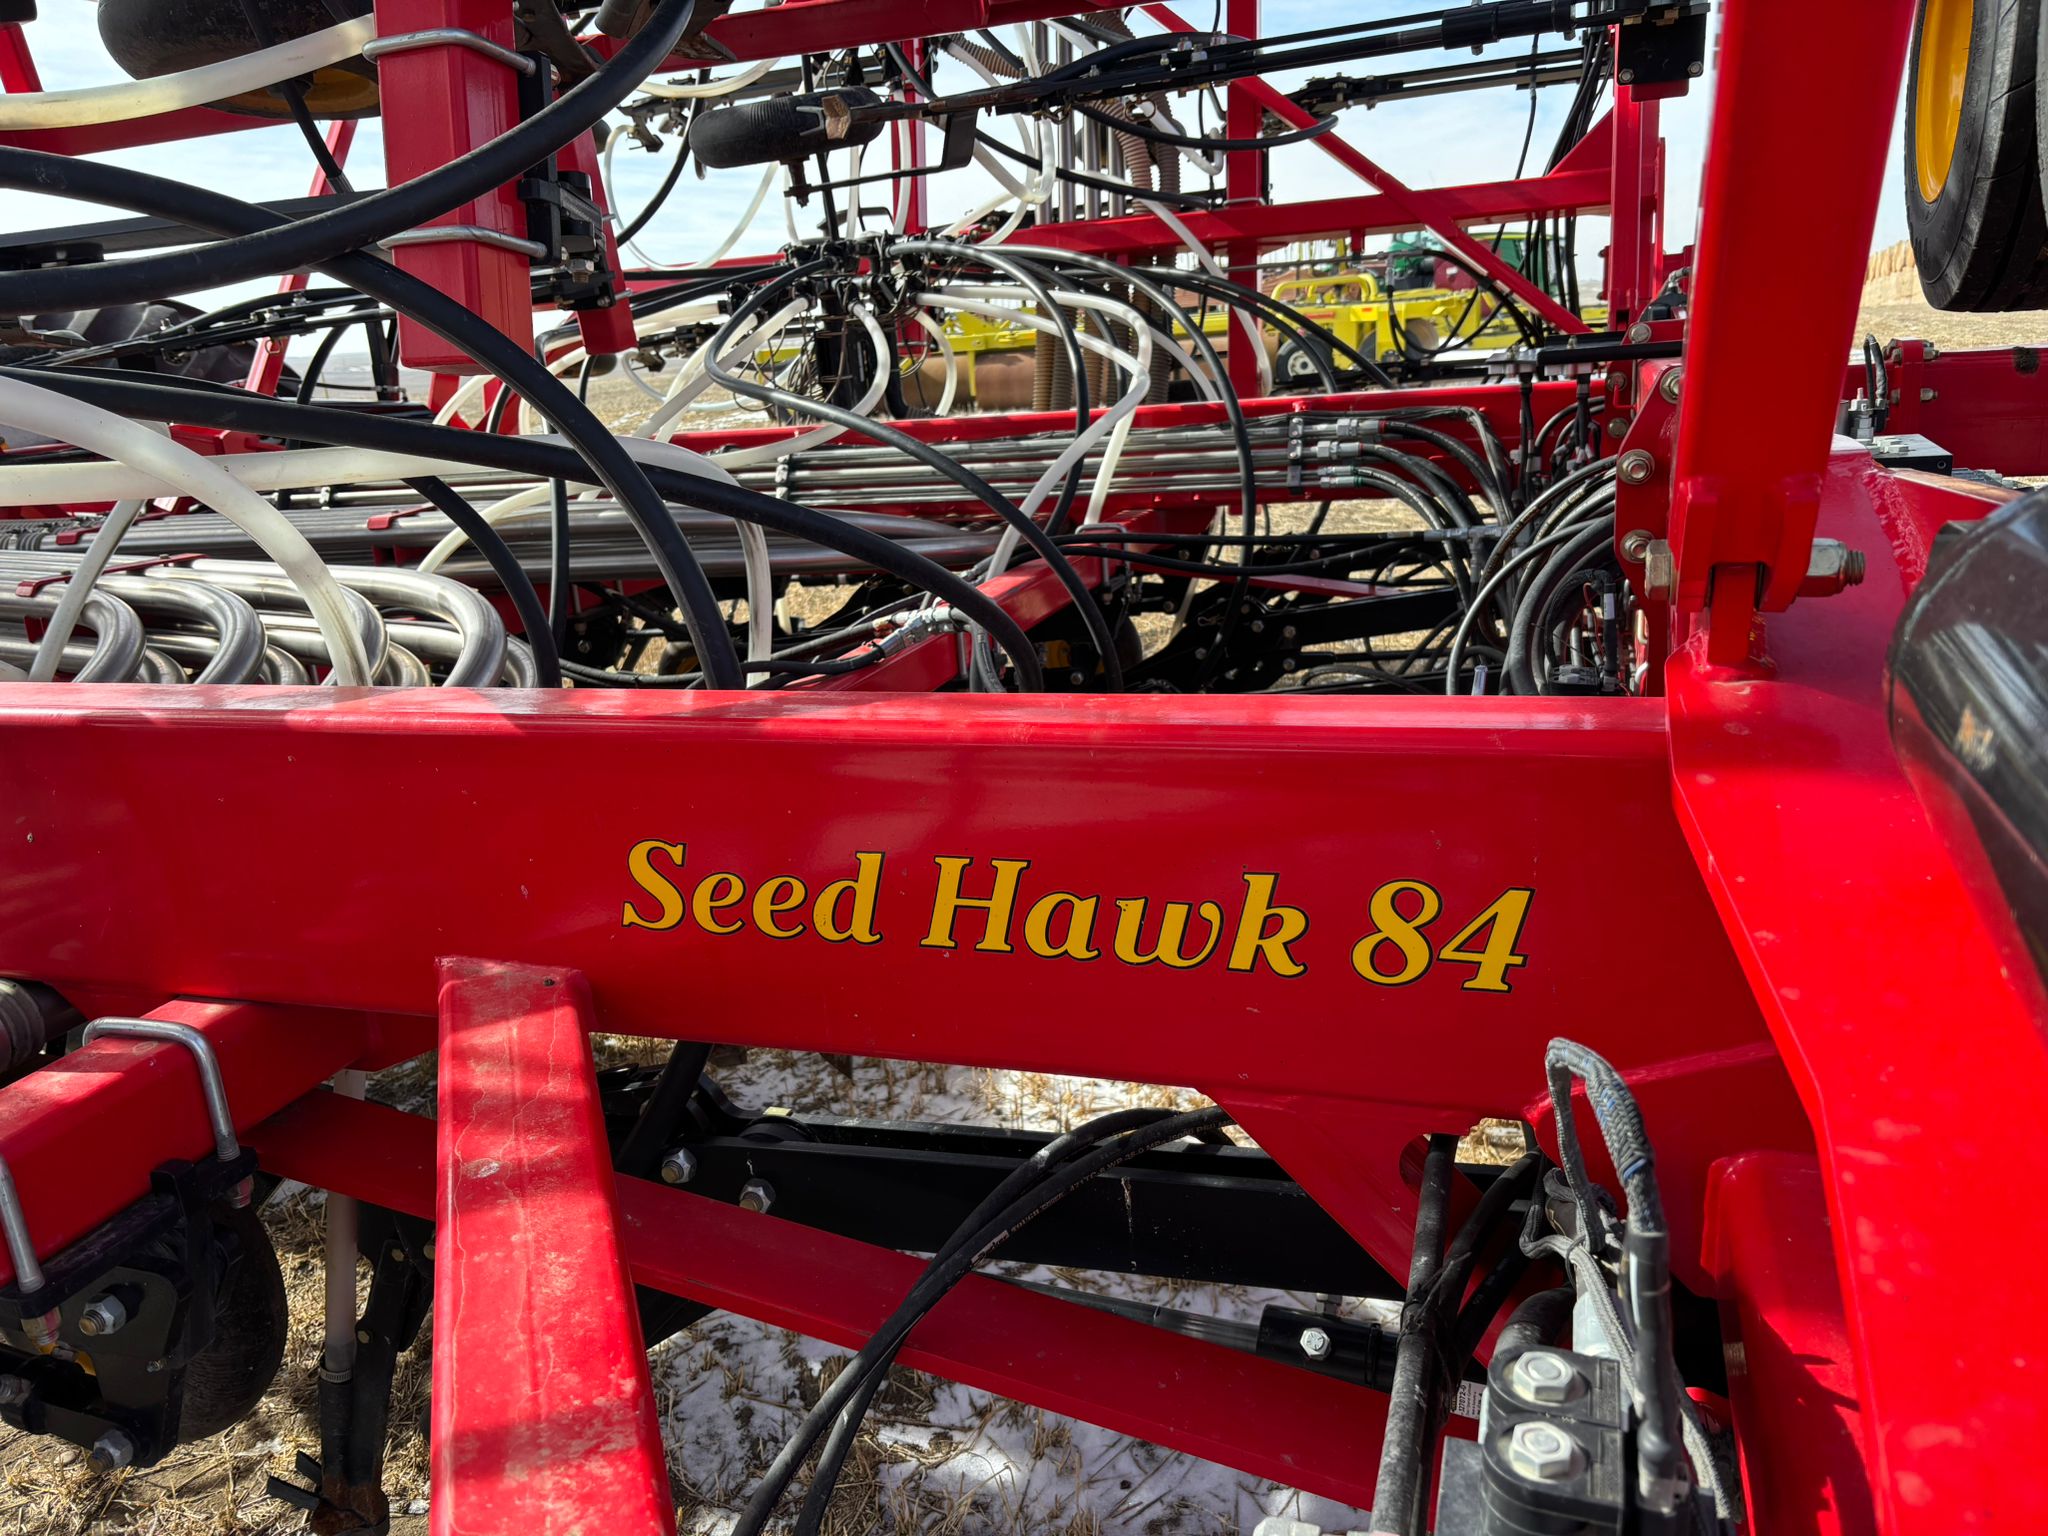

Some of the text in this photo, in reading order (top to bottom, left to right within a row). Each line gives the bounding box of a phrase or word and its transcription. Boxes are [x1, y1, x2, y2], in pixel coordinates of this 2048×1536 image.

[621, 838, 1536, 993] Seed Hawk 84
